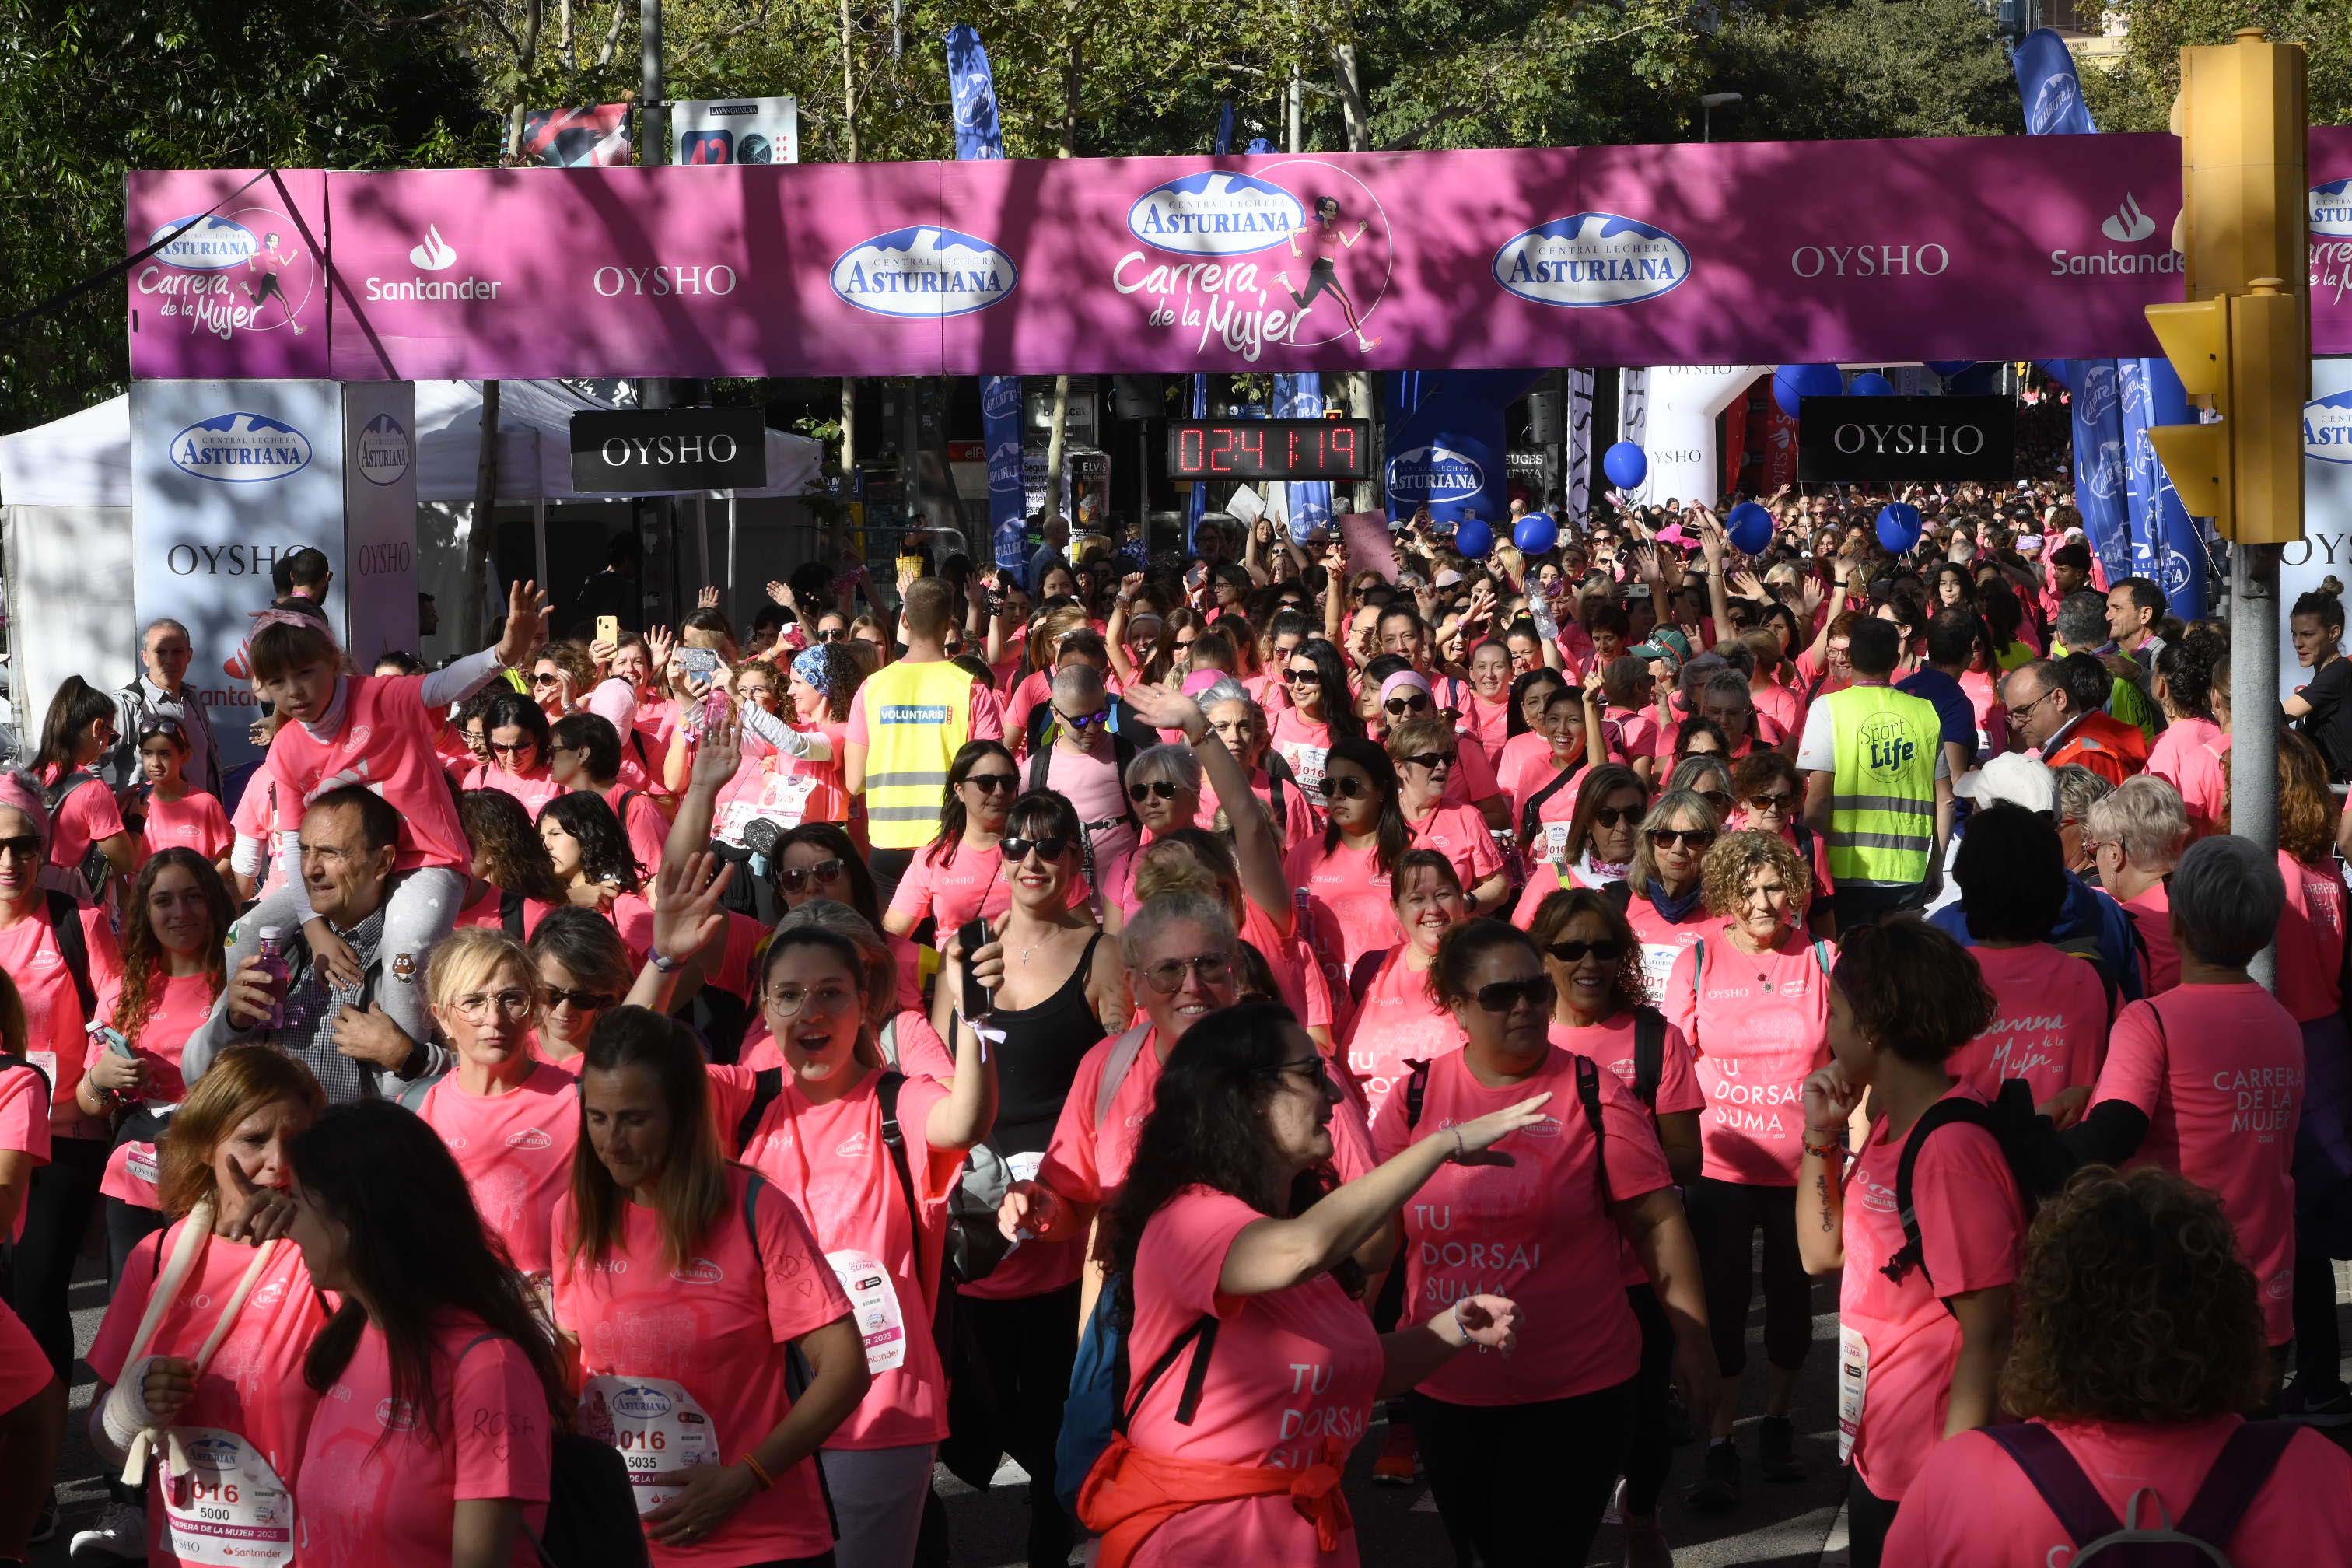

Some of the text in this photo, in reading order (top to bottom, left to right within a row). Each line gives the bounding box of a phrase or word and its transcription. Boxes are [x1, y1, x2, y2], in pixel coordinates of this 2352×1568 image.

[1169, 199, 1286, 208] CENTRAL LECHERA
[1141, 202, 1290, 234] ASTURIANA
[1538, 243, 1669, 255] CENTRAL LECHERA
[1790, 243, 1950, 278] OYSHO
[873, 257, 997, 268] CENTRAL LECHERA
[1113, 250, 1259, 295] Carrera
[1507, 248, 1675, 285] ASTURIANA
[2050, 248, 2186, 275] Santande
[138, 264, 231, 296] Carrera
[593, 264, 737, 297] OYSHO
[845, 258, 1003, 295] ASTURIANA
[366, 276, 502, 302] Santander
[160, 292, 265, 340] de la Mujer
[1149, 289, 1313, 363] de la Mujer
[202, 436, 297, 445] CENTRAL LECHERA
[602, 433, 737, 467] OYSHO
[1181, 428, 1354, 471] 02:41:19
[1834, 423, 1984, 455] OYSHO
[180, 439, 302, 466] ASTURIANA
[361, 440, 406, 467] ASTURIANA
[1654, 449, 1702, 464] YSHO
[1024, 463, 1048, 474] Segur
[1083, 462, 1107, 472] ELVIS
[1390, 469, 1478, 491] ASTURIANA
[167, 544, 314, 576] OYSH
[359, 541, 410, 576] OYSHO
[880, 709, 944, 720] VOLUNTARIS
[1860, 719, 1906, 745] Sport
[1870, 737, 1914, 772] Life
[1303, 766, 1325, 778] 016
[1646, 976, 1664, 989] 01
[1707, 987, 1749, 999] OYSHO
[1713, 1057, 1738, 1077] TU
[1989, 1036, 2053, 1084] Mujer
[2213, 1066, 2304, 1091] CARRERA
[2236, 1089, 2292, 1110] DE LA
[1716, 1107, 1783, 1132] SUMA
[2231, 1109, 2292, 1132] MUJER
[508, 1136, 549, 1146] ASTURIANA
[1413, 1205, 1451, 1230] TU
[849, 1263, 876, 1273] SUMA
[873, 1332, 891, 1343] 2023
[868, 1349, 898, 1364] ntander
[1289, 1363, 1334, 1395] TU
[617, 1398, 667, 1412] ASTURIANA
[471, 1407, 536, 1440] ROSA
[620, 1430, 667, 1451] 016
[628, 1456, 656, 1468] 5035
[191, 1480, 240, 1503] 016
[200, 1507, 229, 1521] 5000
[200, 1524, 212, 1534] DE
[213, 1527, 223, 1535] LA
[225, 1529, 254, 1538] MUJER
[257, 1530, 278, 1538] 2023
[173, 1537, 282, 1559] YSHO Santander
